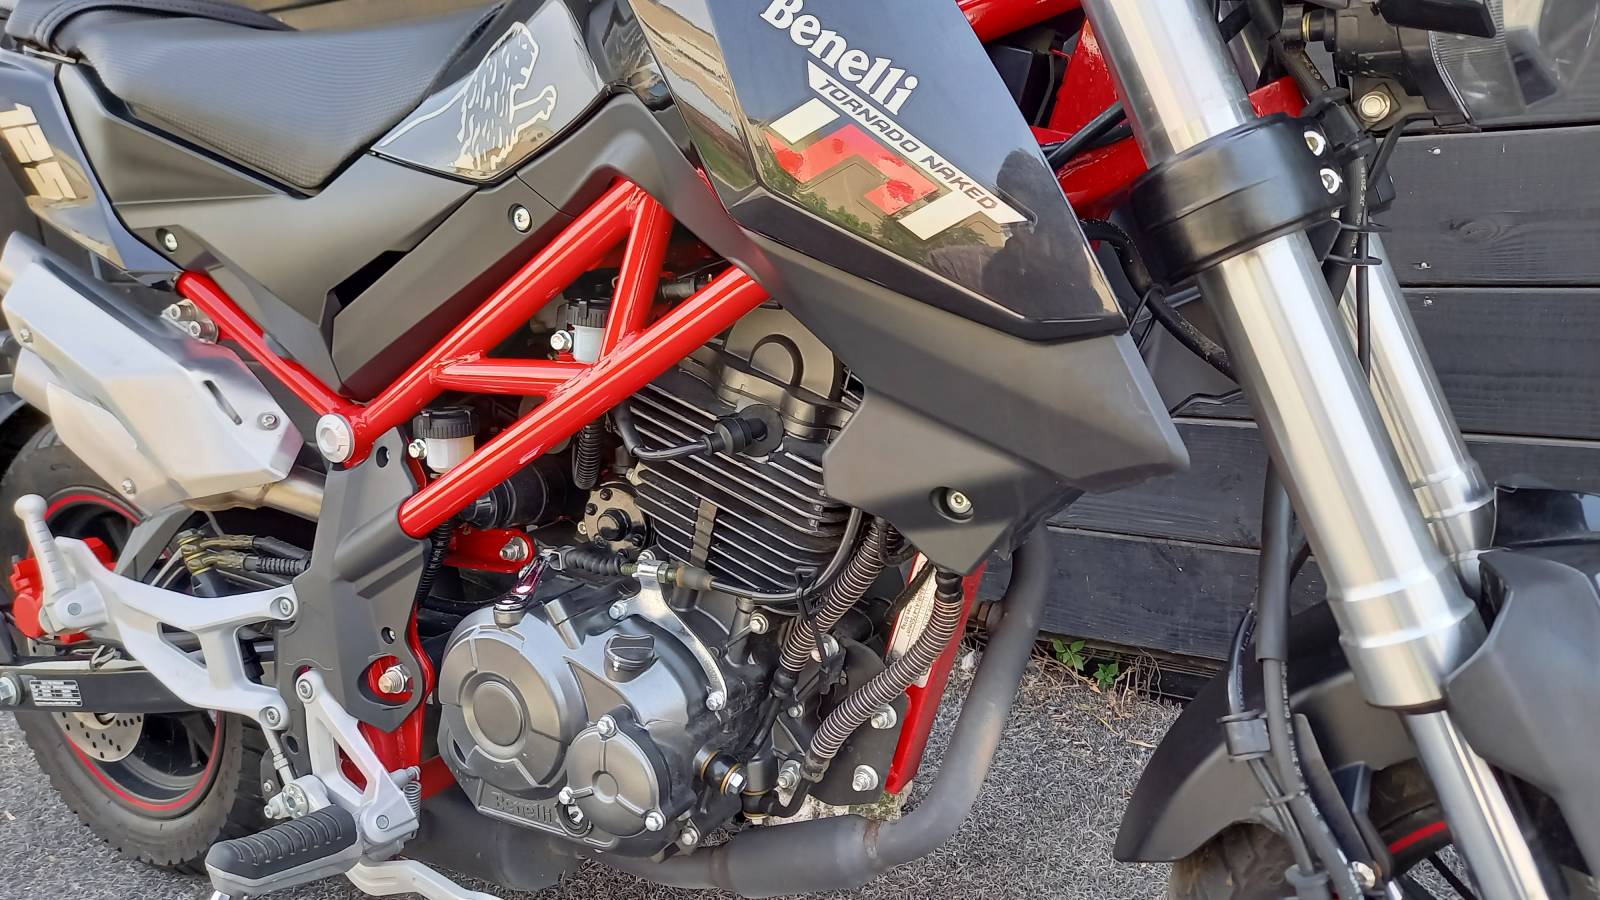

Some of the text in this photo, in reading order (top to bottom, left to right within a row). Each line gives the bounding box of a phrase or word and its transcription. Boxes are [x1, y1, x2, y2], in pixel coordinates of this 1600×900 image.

[760, 0, 919, 116] Benelli
[0, 102, 77, 200] 125
[818, 78, 998, 210] TORNADO NAKED
